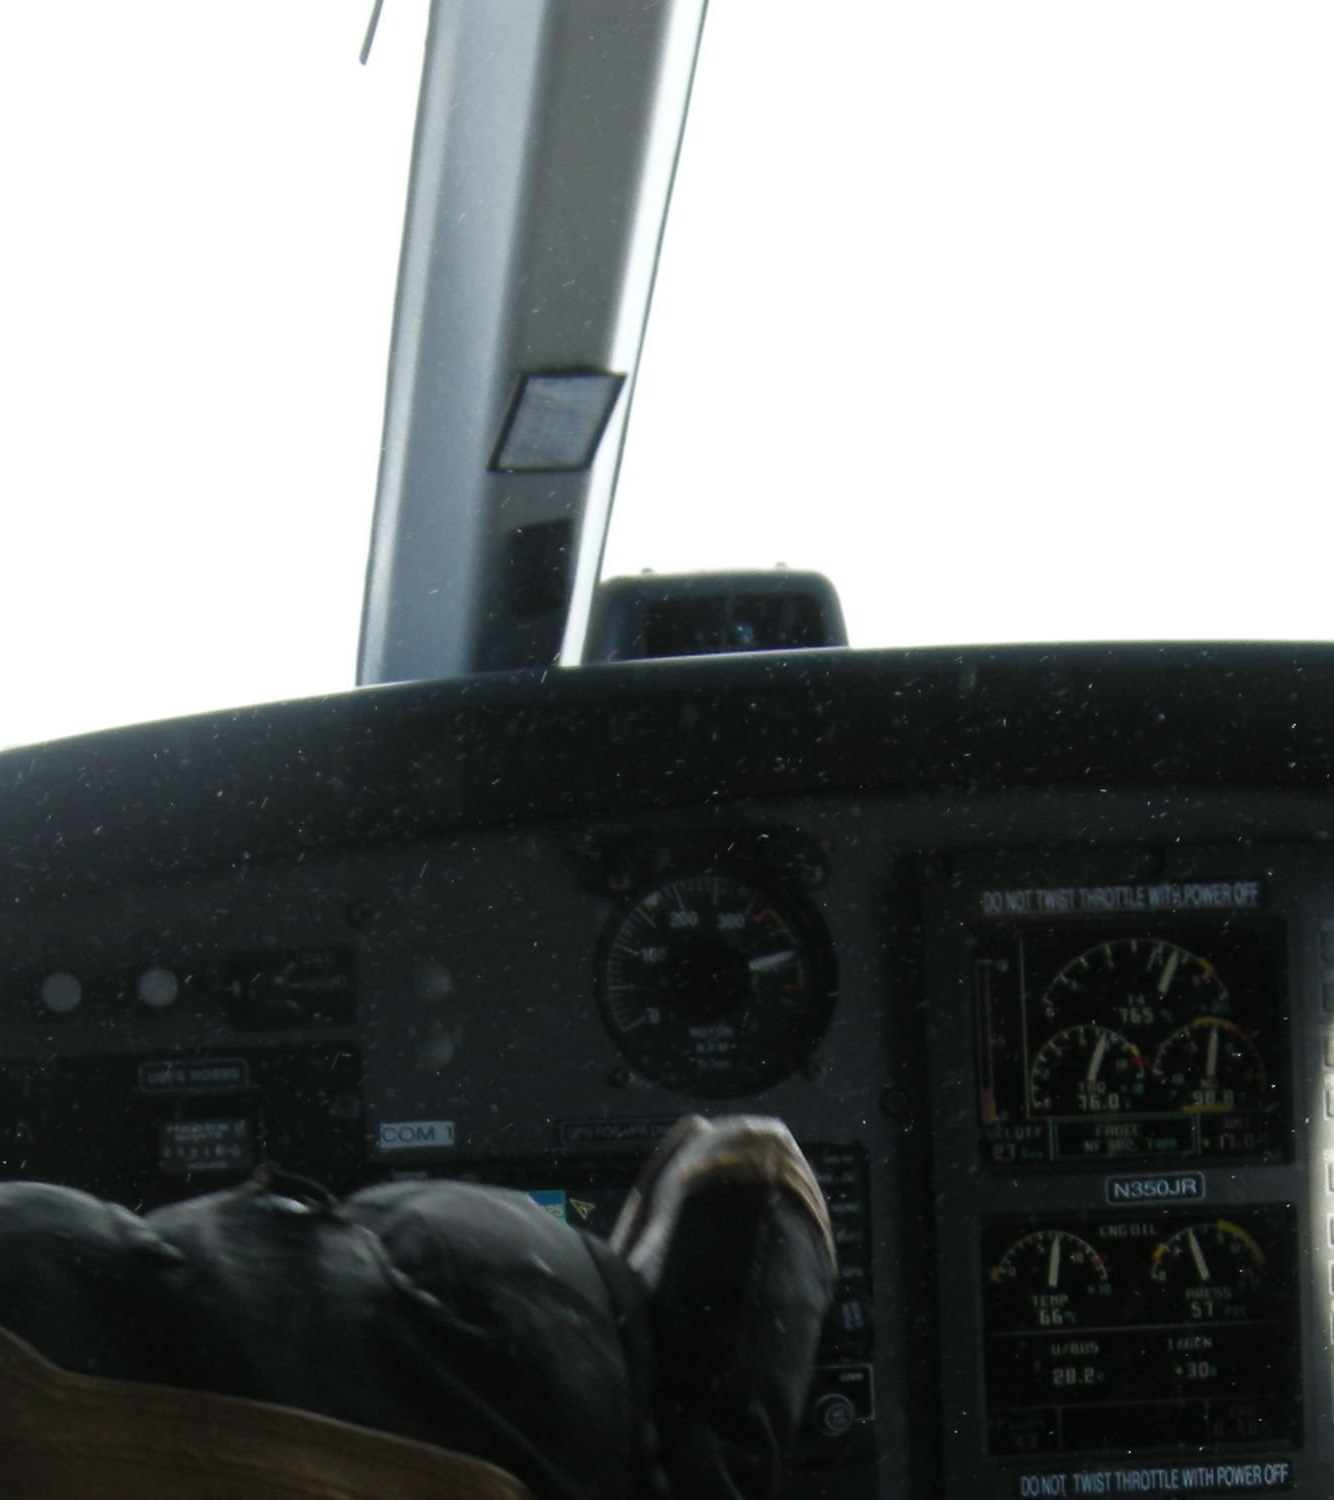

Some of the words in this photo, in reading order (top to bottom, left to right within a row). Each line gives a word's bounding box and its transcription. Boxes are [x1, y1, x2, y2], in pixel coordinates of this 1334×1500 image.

[1234, 882, 1259, 904] OFF
[381, 1126, 436, 1144] COM
[1113, 1178, 1198, 1199] N350JR
[1052, 1367, 1095, 1386] 28.2
[1020, 1475, 1040, 1497] DO
[1041, 1474, 1066, 1496] NOT
[1073, 1472, 1112, 1494] TWIST
[1116, 1468, 1180, 1491] THROTTLE
[1182, 1466, 1214, 1489] WITH
[1217, 1464, 1262, 1487] POWER
[1264, 1462, 1289, 1484] OFF
